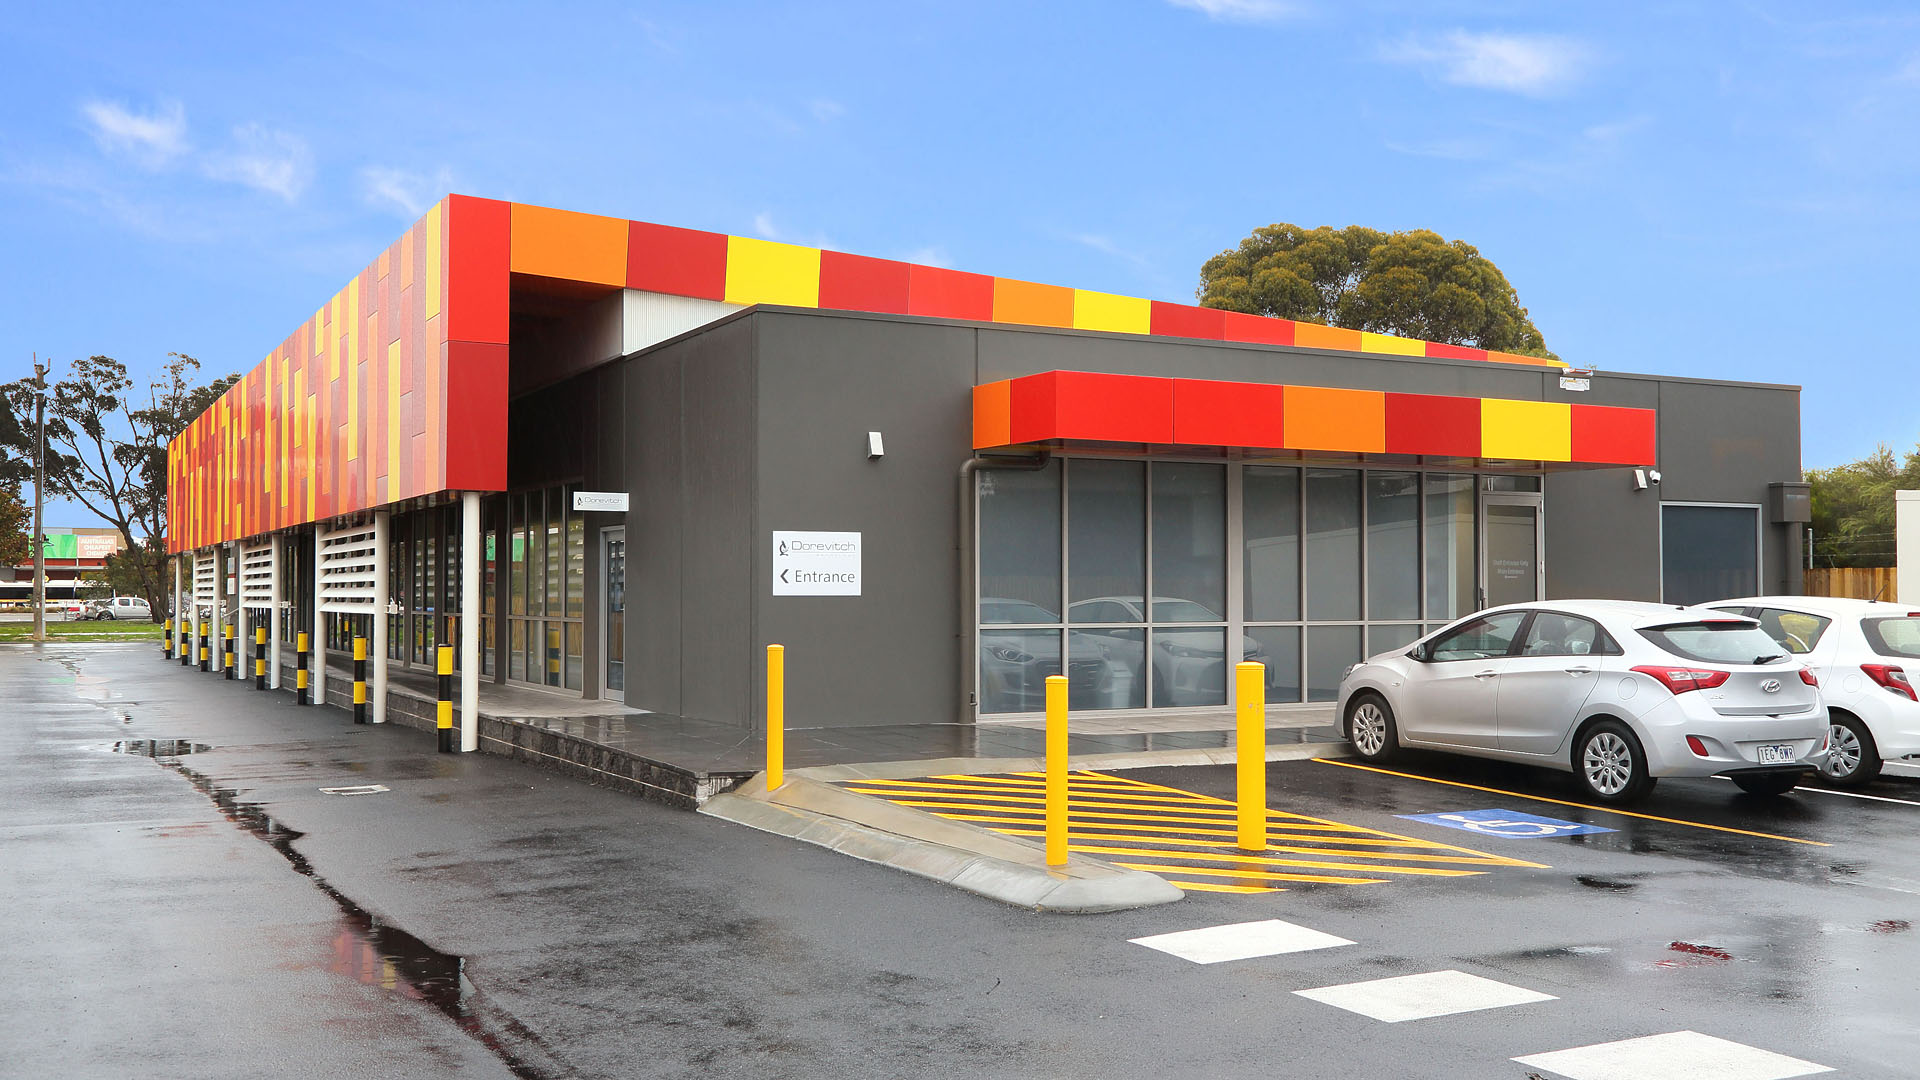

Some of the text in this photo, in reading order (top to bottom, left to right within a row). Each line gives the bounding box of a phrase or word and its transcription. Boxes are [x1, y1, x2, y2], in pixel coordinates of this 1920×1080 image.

[584, 496, 623, 504] Dorevitch
[791, 540, 856, 551] Dorevitch
[795, 569, 856, 583] Entrance
